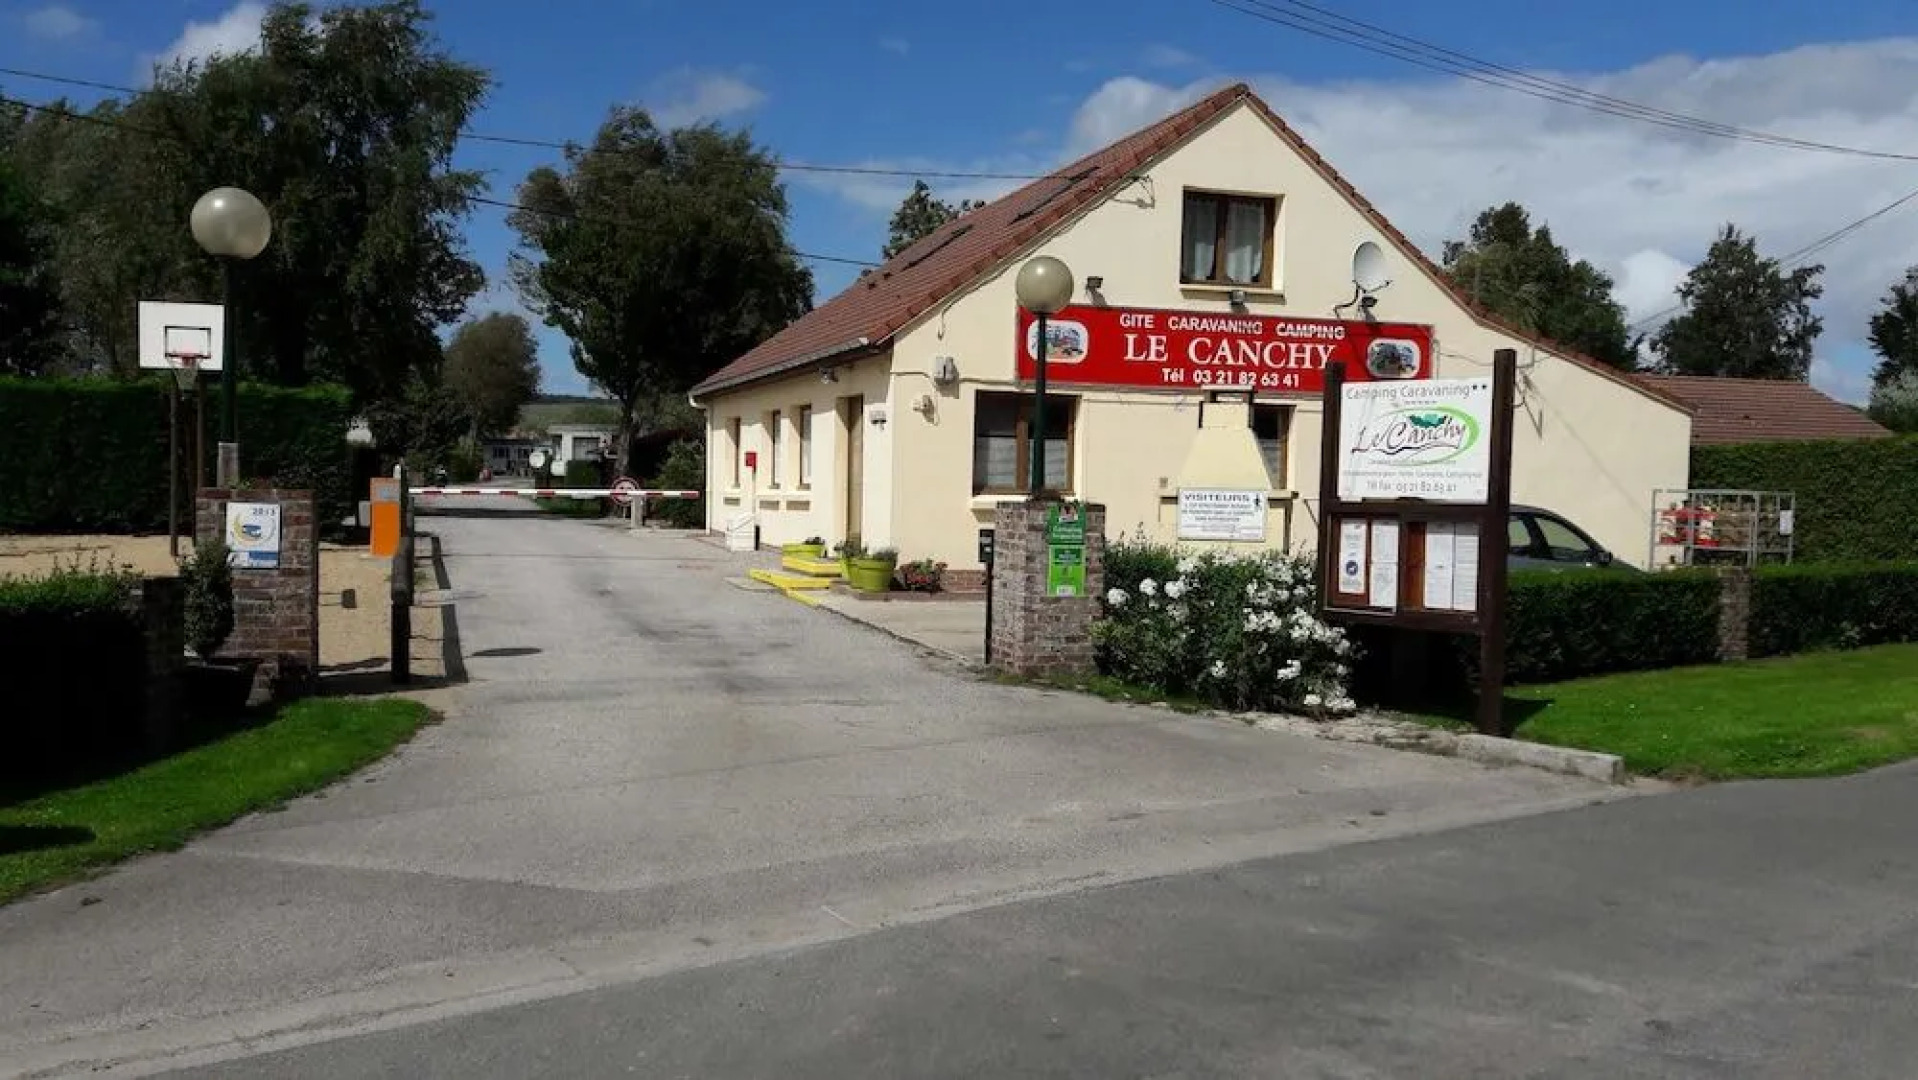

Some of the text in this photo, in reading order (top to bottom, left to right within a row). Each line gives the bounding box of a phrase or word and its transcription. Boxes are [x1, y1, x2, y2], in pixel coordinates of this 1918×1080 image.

[1120, 312, 1346, 340] GITE CARAVANING CAMPING
[1123, 333, 1337, 370] LE CANCHY
[1161, 367, 1300, 388] Tél 03 21 82 63 41
[1345, 384, 1470, 401] Camping Caravaning
[1184, 492, 1250, 502] VISITEURS
